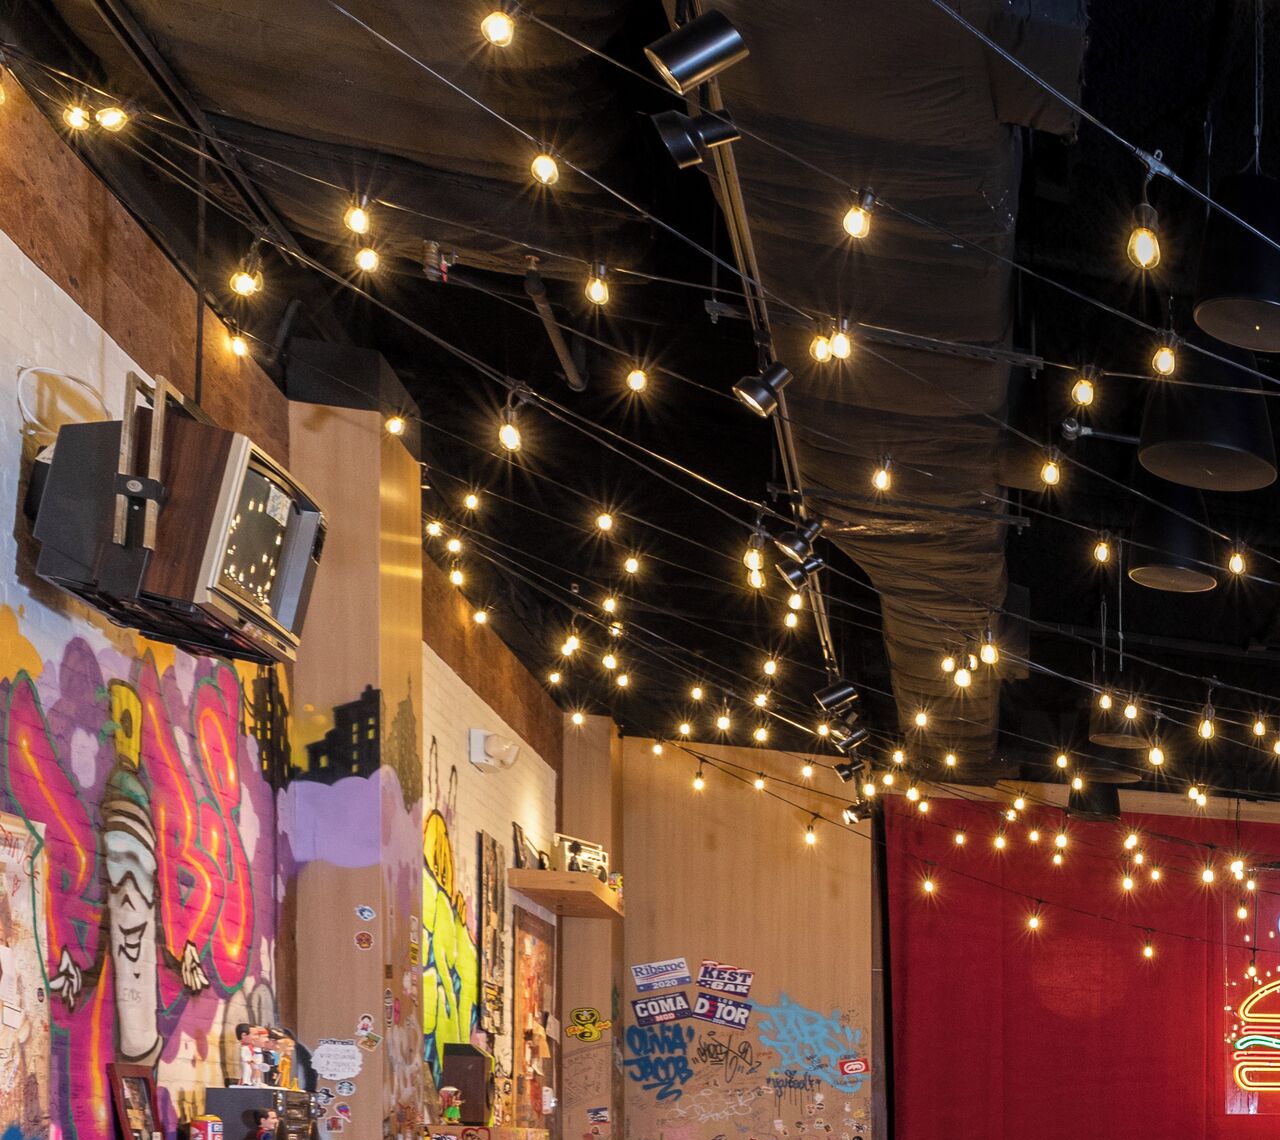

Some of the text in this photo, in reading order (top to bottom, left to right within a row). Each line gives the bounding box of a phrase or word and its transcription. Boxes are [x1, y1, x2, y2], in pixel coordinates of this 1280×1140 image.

[633, 961, 686, 977] Ribsroc
[701, 964, 751, 983] KEST
[652, 979, 679, 988] 2020
[711, 981, 748, 993] GAK
[635, 996, 689, 1015] COMA
[695, 1000, 749, 1025] DETOR
